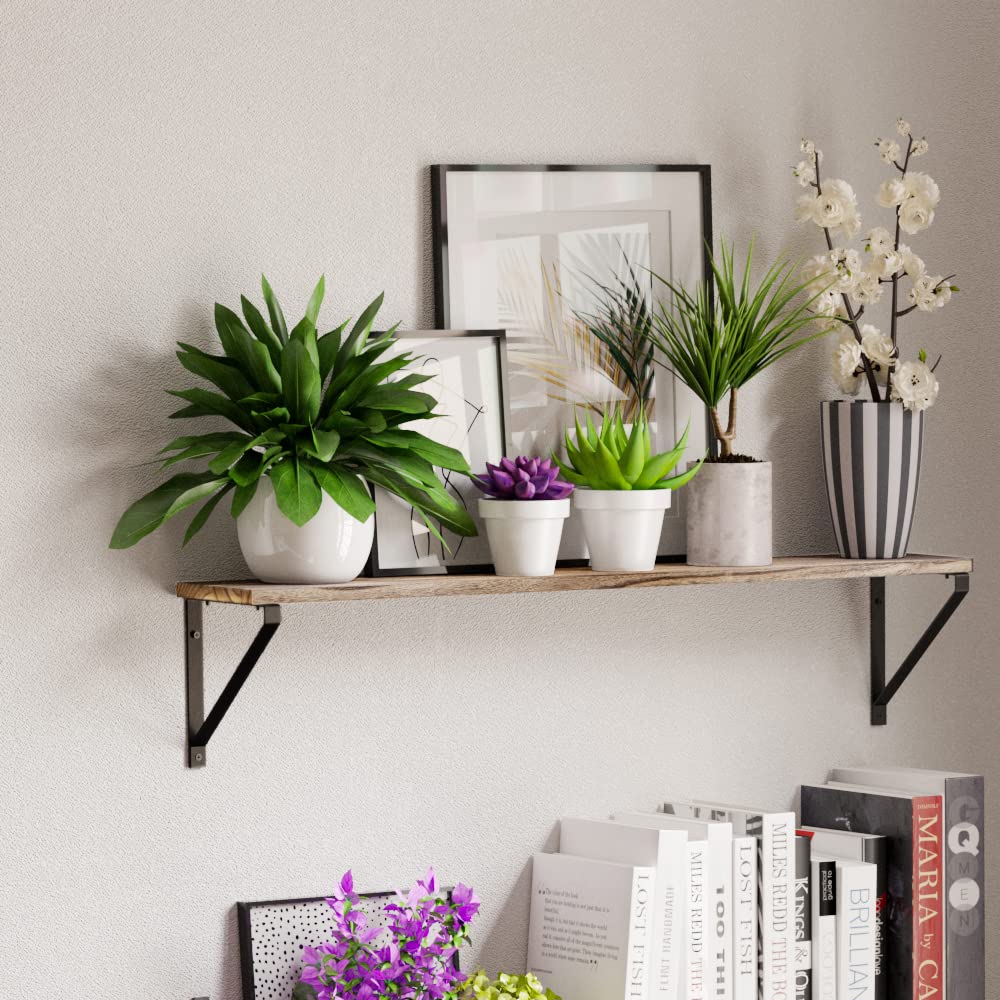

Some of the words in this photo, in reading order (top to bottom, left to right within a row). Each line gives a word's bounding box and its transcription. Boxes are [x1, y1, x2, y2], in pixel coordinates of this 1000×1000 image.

[771, 823, 788, 879] MILES
[918, 814, 939, 926] MARIA
[690, 852, 703, 903] MILES
[739, 846, 753, 912] LOST
[634, 874, 649, 936] LOST
[690, 908, 703, 953] REDD
[772, 883, 788, 932] REDD
[740, 920, 753, 975] FISH
[771, 937, 788, 975] THE
[919, 933, 934, 950] by
[630, 943, 645, 997] FISH
[690, 957, 703, 992] THE
